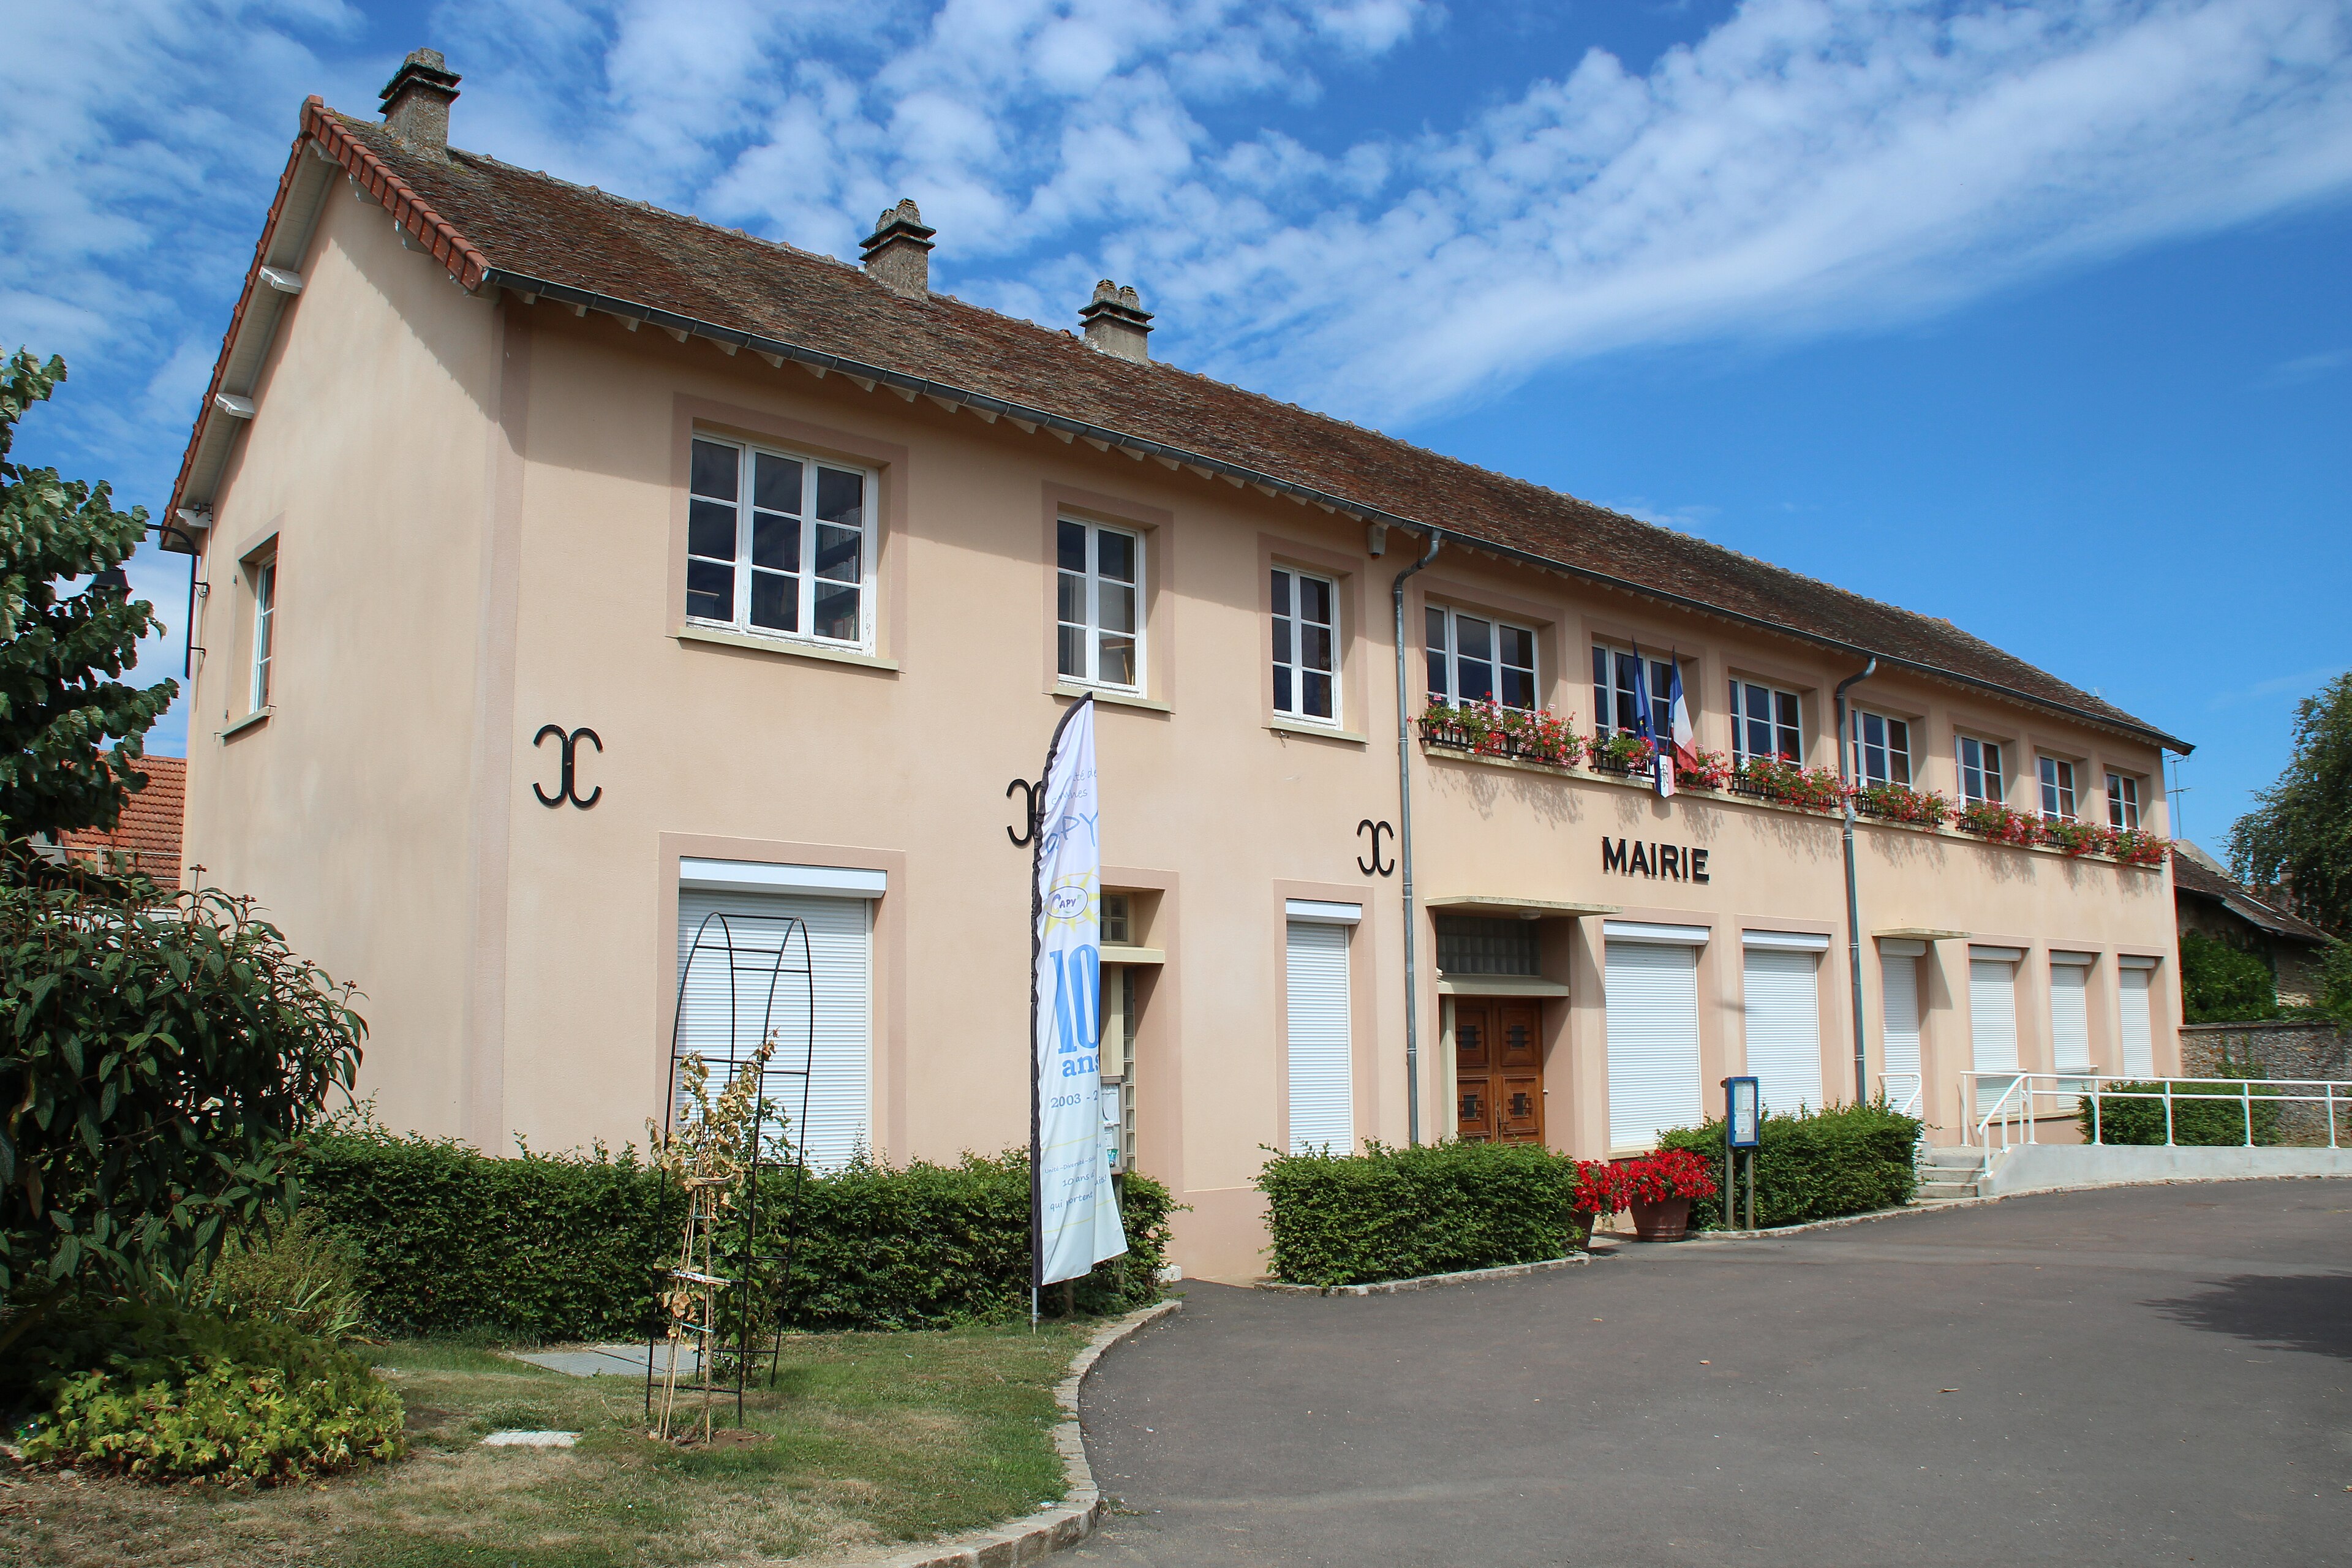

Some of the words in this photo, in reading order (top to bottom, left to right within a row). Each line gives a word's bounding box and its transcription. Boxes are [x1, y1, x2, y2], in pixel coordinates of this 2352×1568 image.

[1602, 835, 1710, 881] MAIRIE
[1051, 893, 1077, 914] CAPY
[1049, 944, 1099, 1054] 10
[1050, 1093, 1081, 1108] 2003
[1062, 1178, 1074, 1187] 10
[1076, 1174, 1090, 1183] ans
[1050, 1199, 1063, 1212] qui
